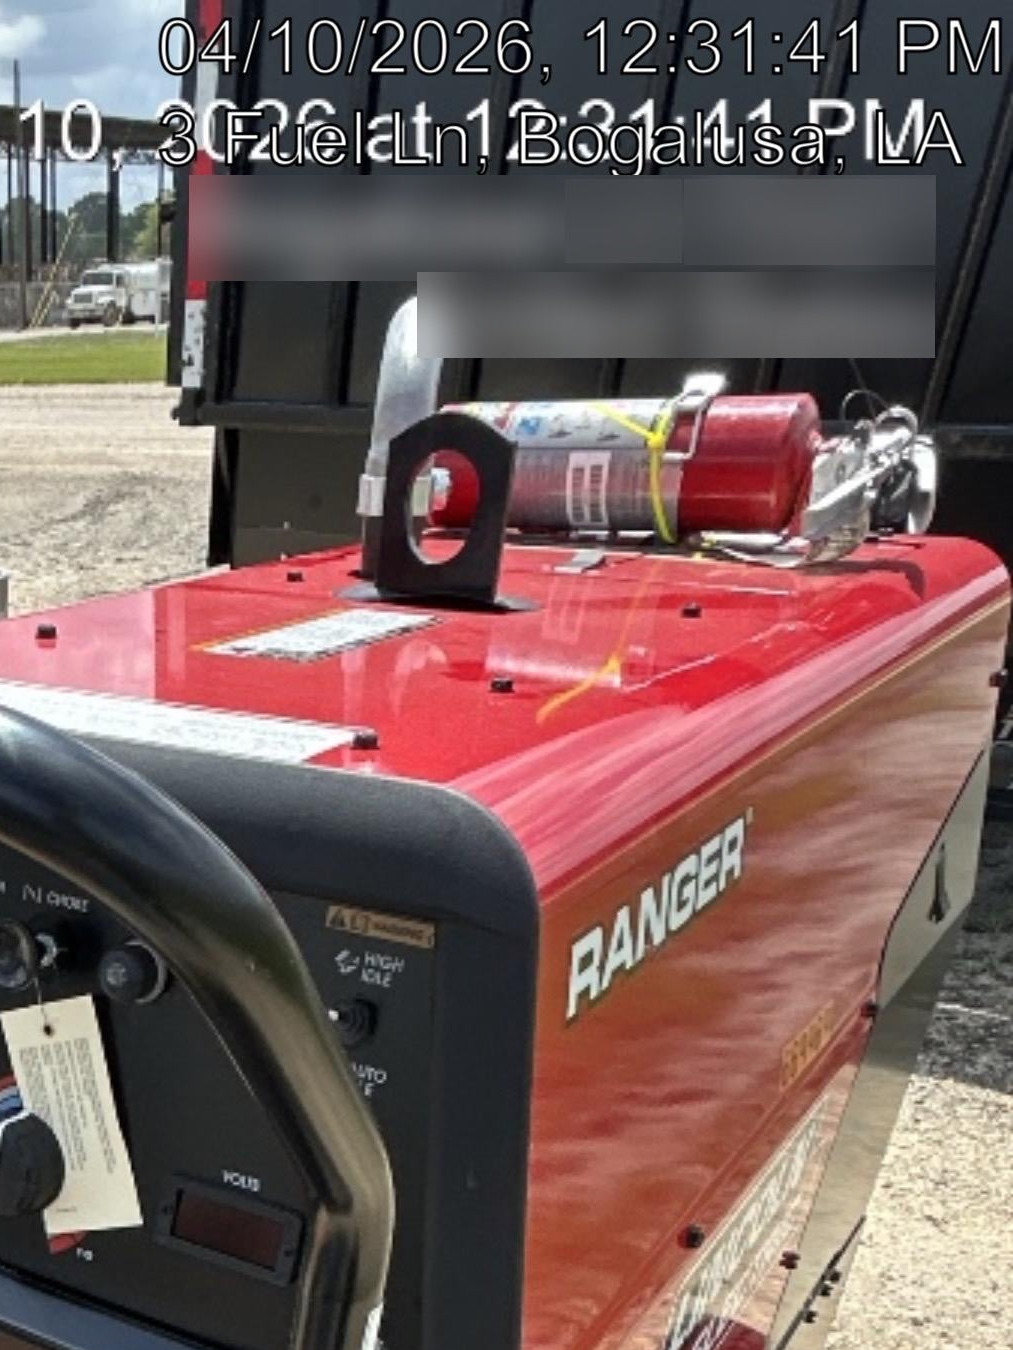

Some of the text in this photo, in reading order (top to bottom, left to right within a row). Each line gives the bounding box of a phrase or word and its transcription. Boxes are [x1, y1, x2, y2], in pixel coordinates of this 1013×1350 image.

[566, 817, 745, 1021] RANGER
[363, 951, 405, 972] HIGH
[361, 967, 393, 988] IDLE
[351, 1062, 388, 1084] UTO
